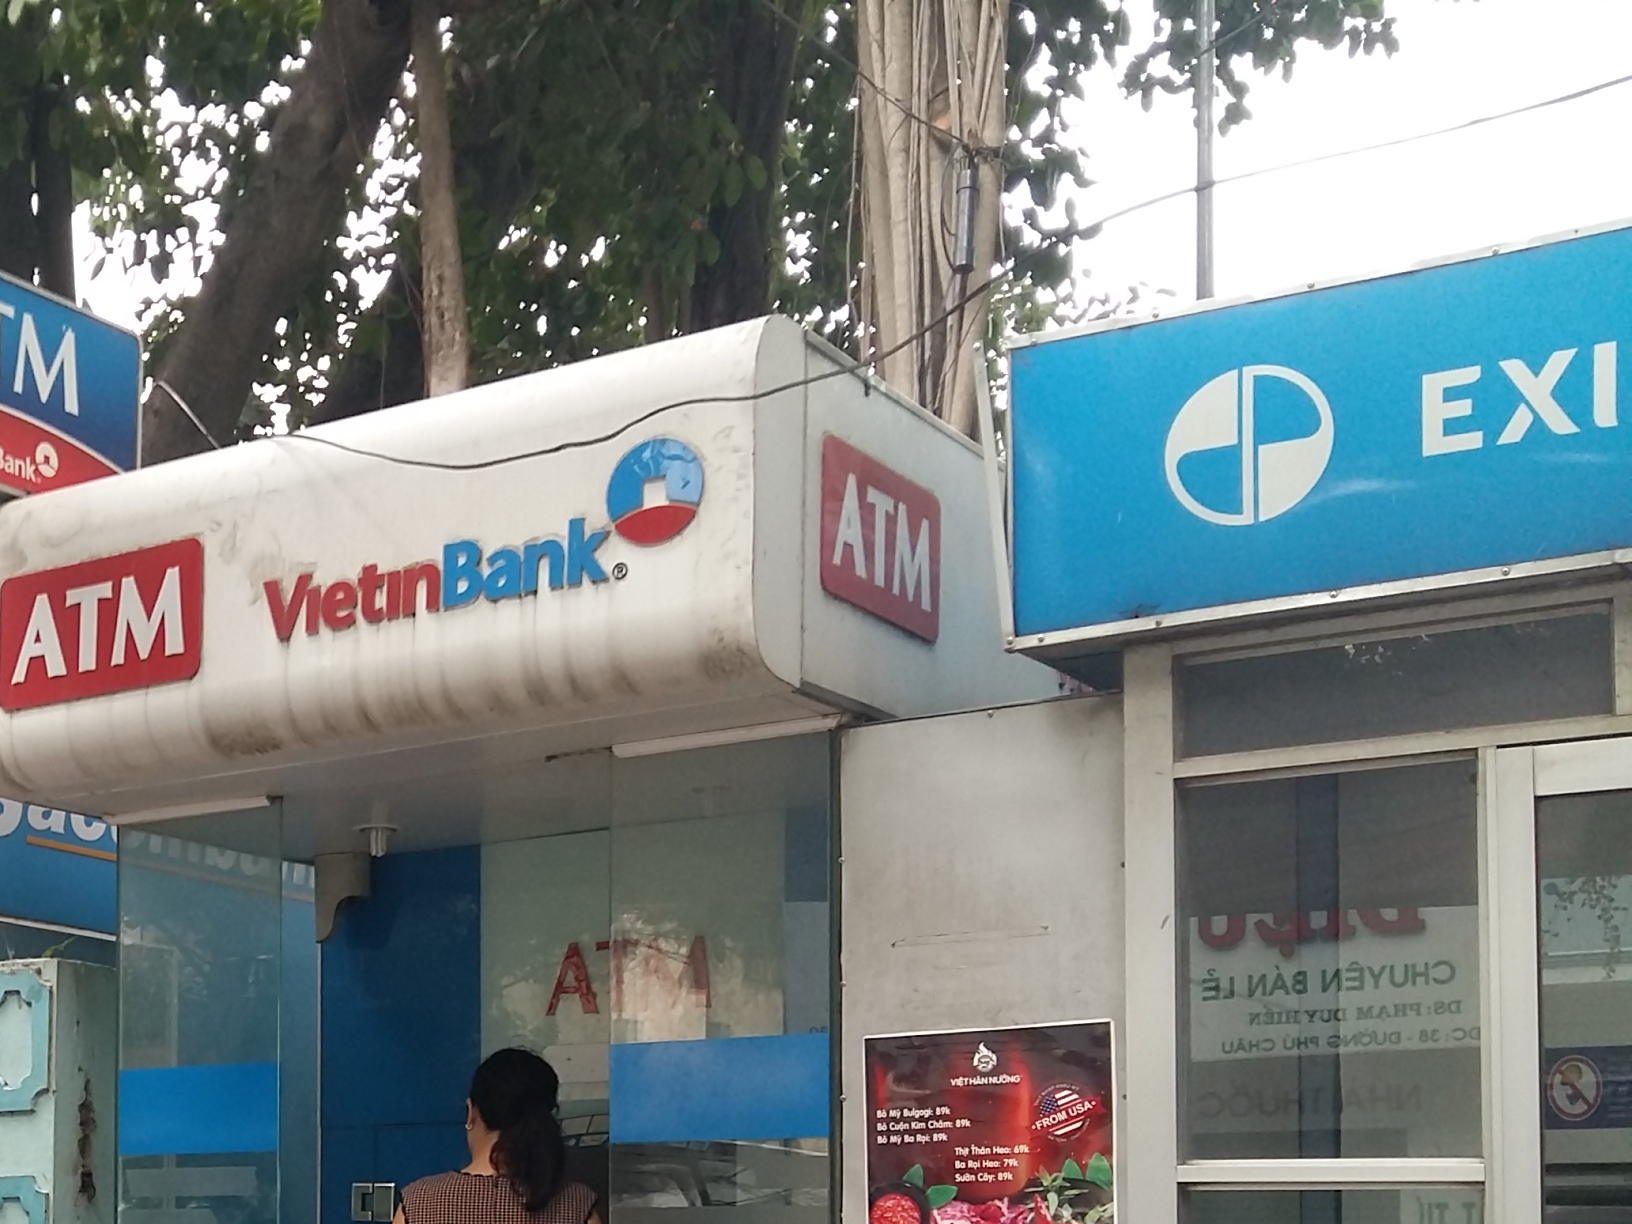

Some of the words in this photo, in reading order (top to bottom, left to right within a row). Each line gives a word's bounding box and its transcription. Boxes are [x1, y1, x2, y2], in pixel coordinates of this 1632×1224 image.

[1422, 340, 1618, 457] EXI
[831, 472, 933, 613] ATM
[10, 565, 186, 686] ATM
[263, 518, 611, 643] VietinBank
[950, 1076, 969, 1087] VIỆT
[935, 1106, 951, 1116] 89k
[1035, 1110, 1068, 1130] FROM
[1067, 1100, 1093, 1117] USA
[911, 1120, 926, 1129] Kim
[955, 1119, 971, 1128] 89k
[904, 1134, 914, 1143] Ba
[932, 1133, 948, 1142] 89k
[992, 1146, 1011, 1155] Heo:
[1013, 1145, 1030, 1154] 69k
[955, 1160, 966, 1169] Ba
[982, 1159, 1001, 1168] Heo:
[1003, 1158, 1018, 1168] 79k
[997, 1172, 1013, 1181] 89k
